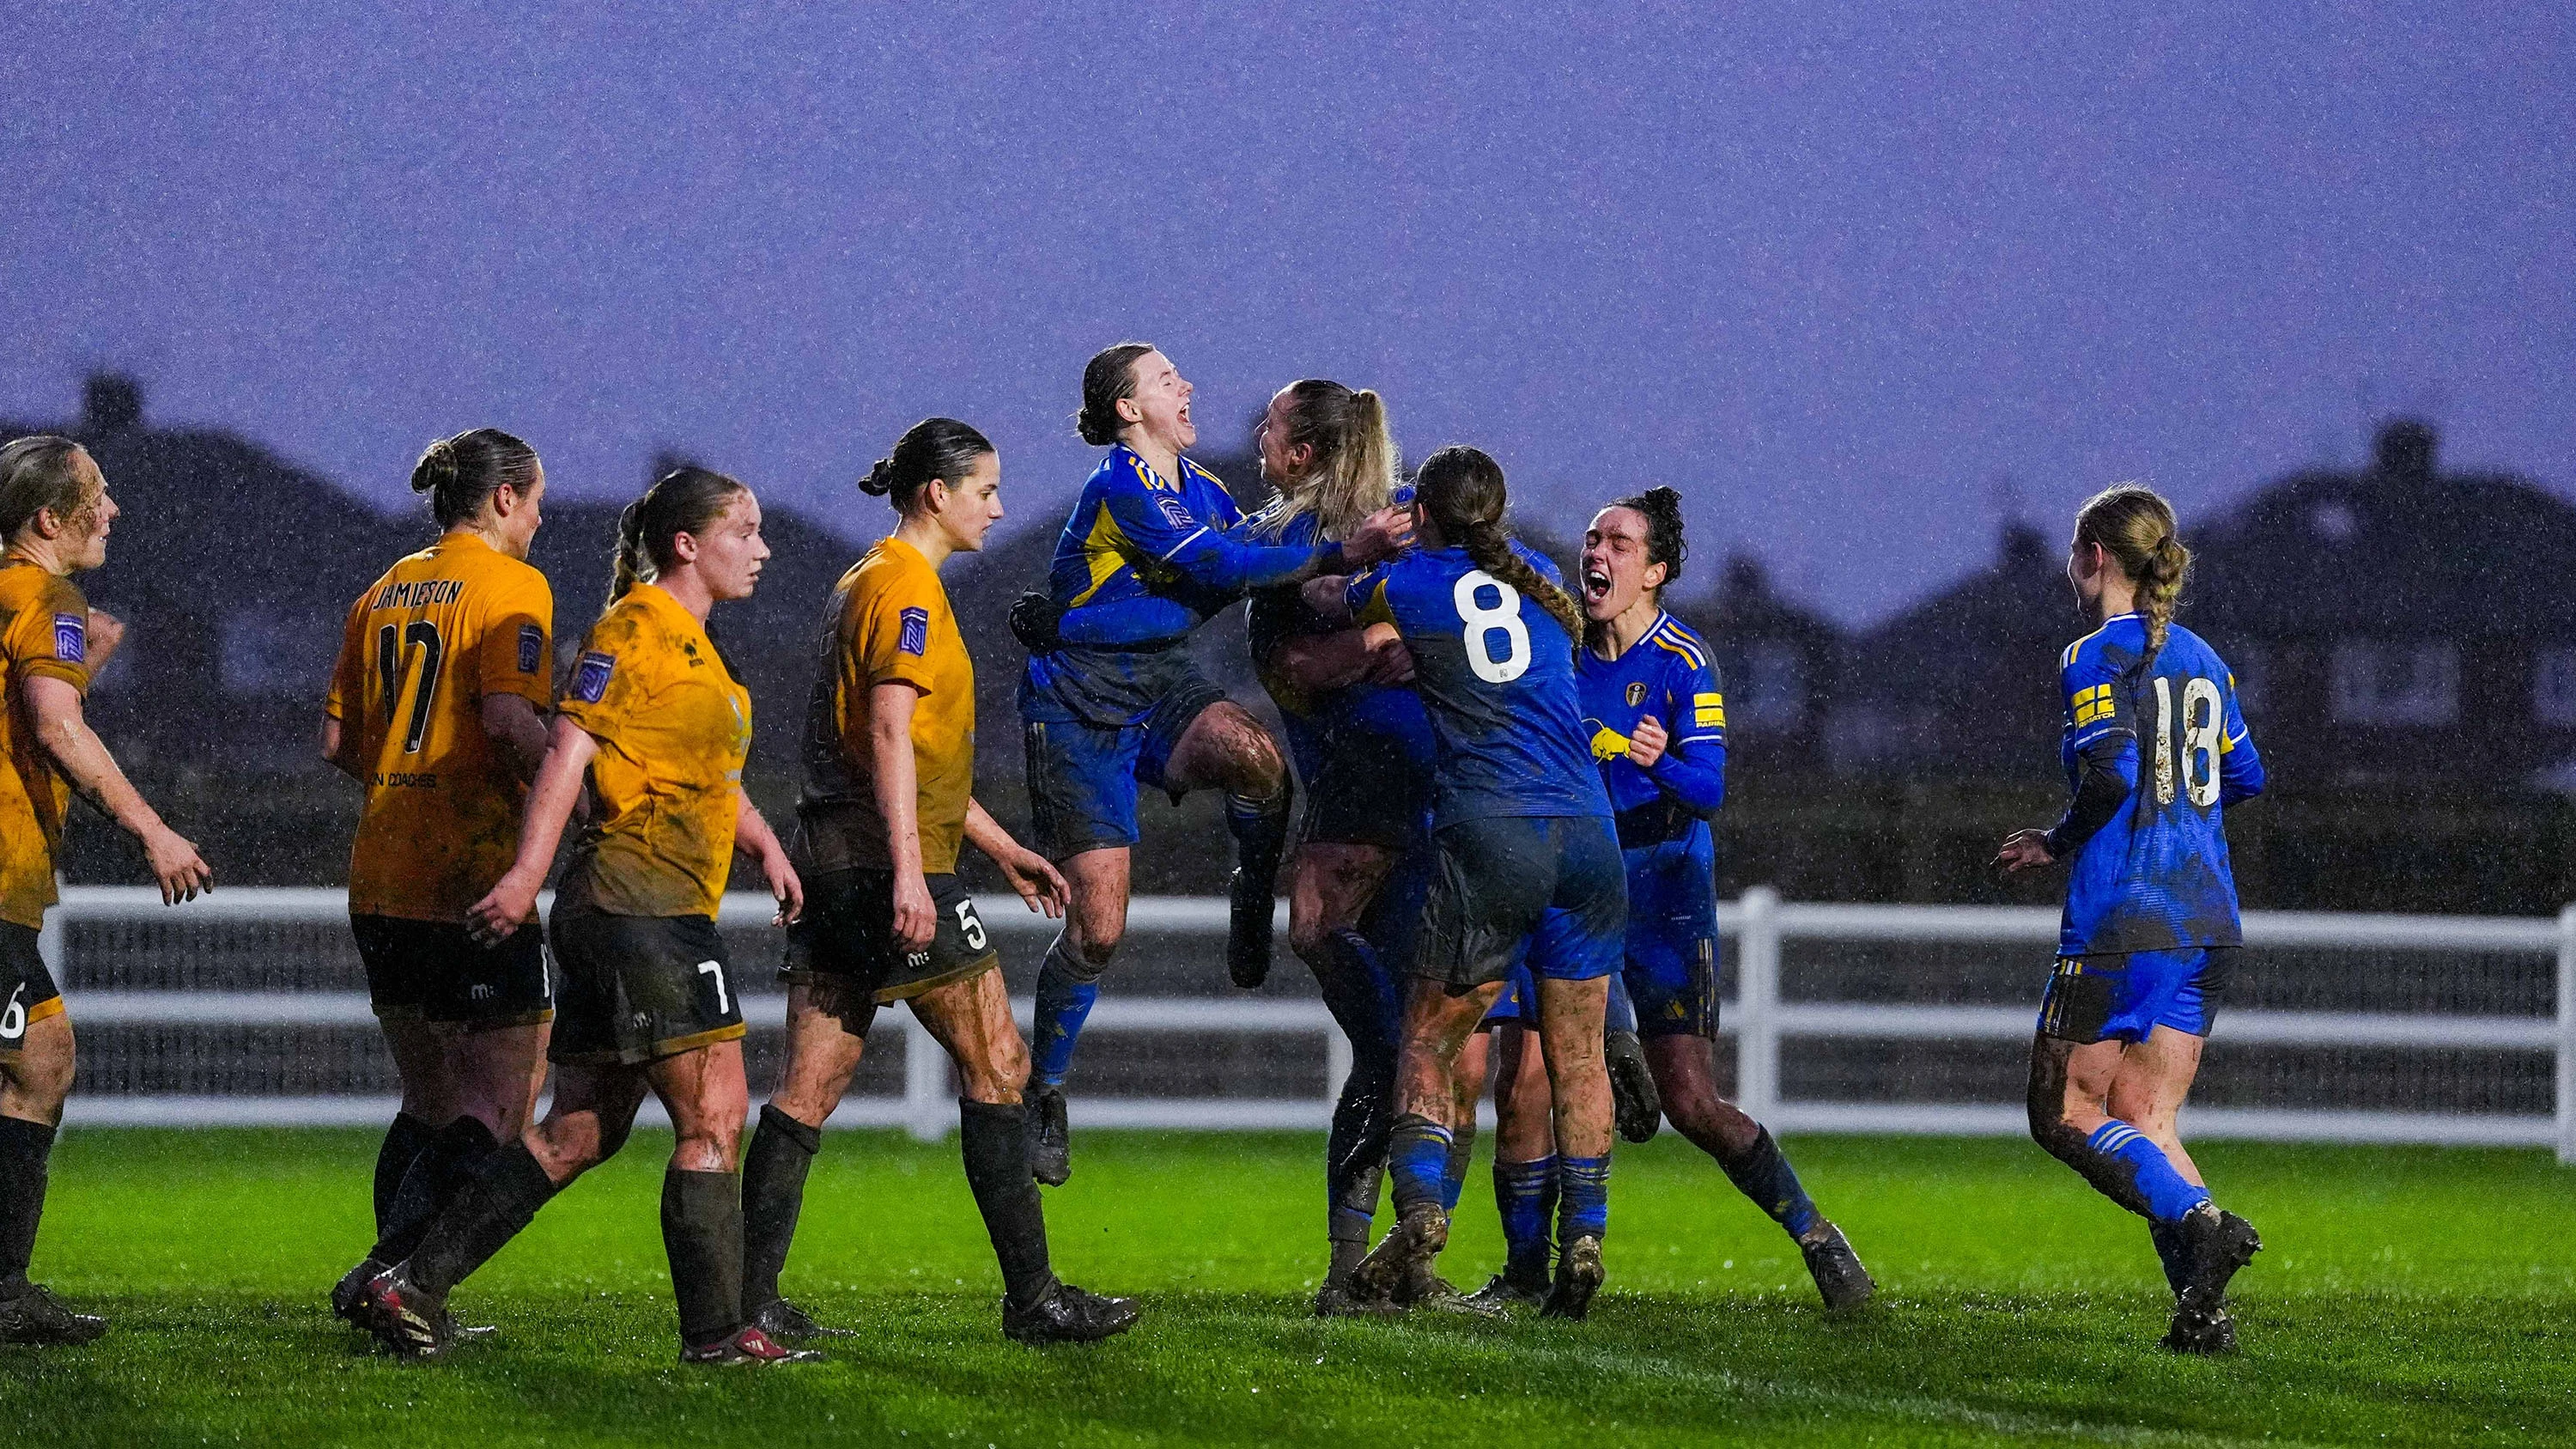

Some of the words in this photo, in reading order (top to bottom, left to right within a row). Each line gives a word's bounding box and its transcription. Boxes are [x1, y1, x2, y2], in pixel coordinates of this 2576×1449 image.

[372, 580, 464, 610] JAMIESON
[1454, 569, 1531, 683] 8
[379, 620, 442, 753] 17
[2154, 676, 2222, 807] 18
[955, 899, 987, 950] 5
[0, 982, 26, 1039] 6
[697, 959, 730, 1014] 7
